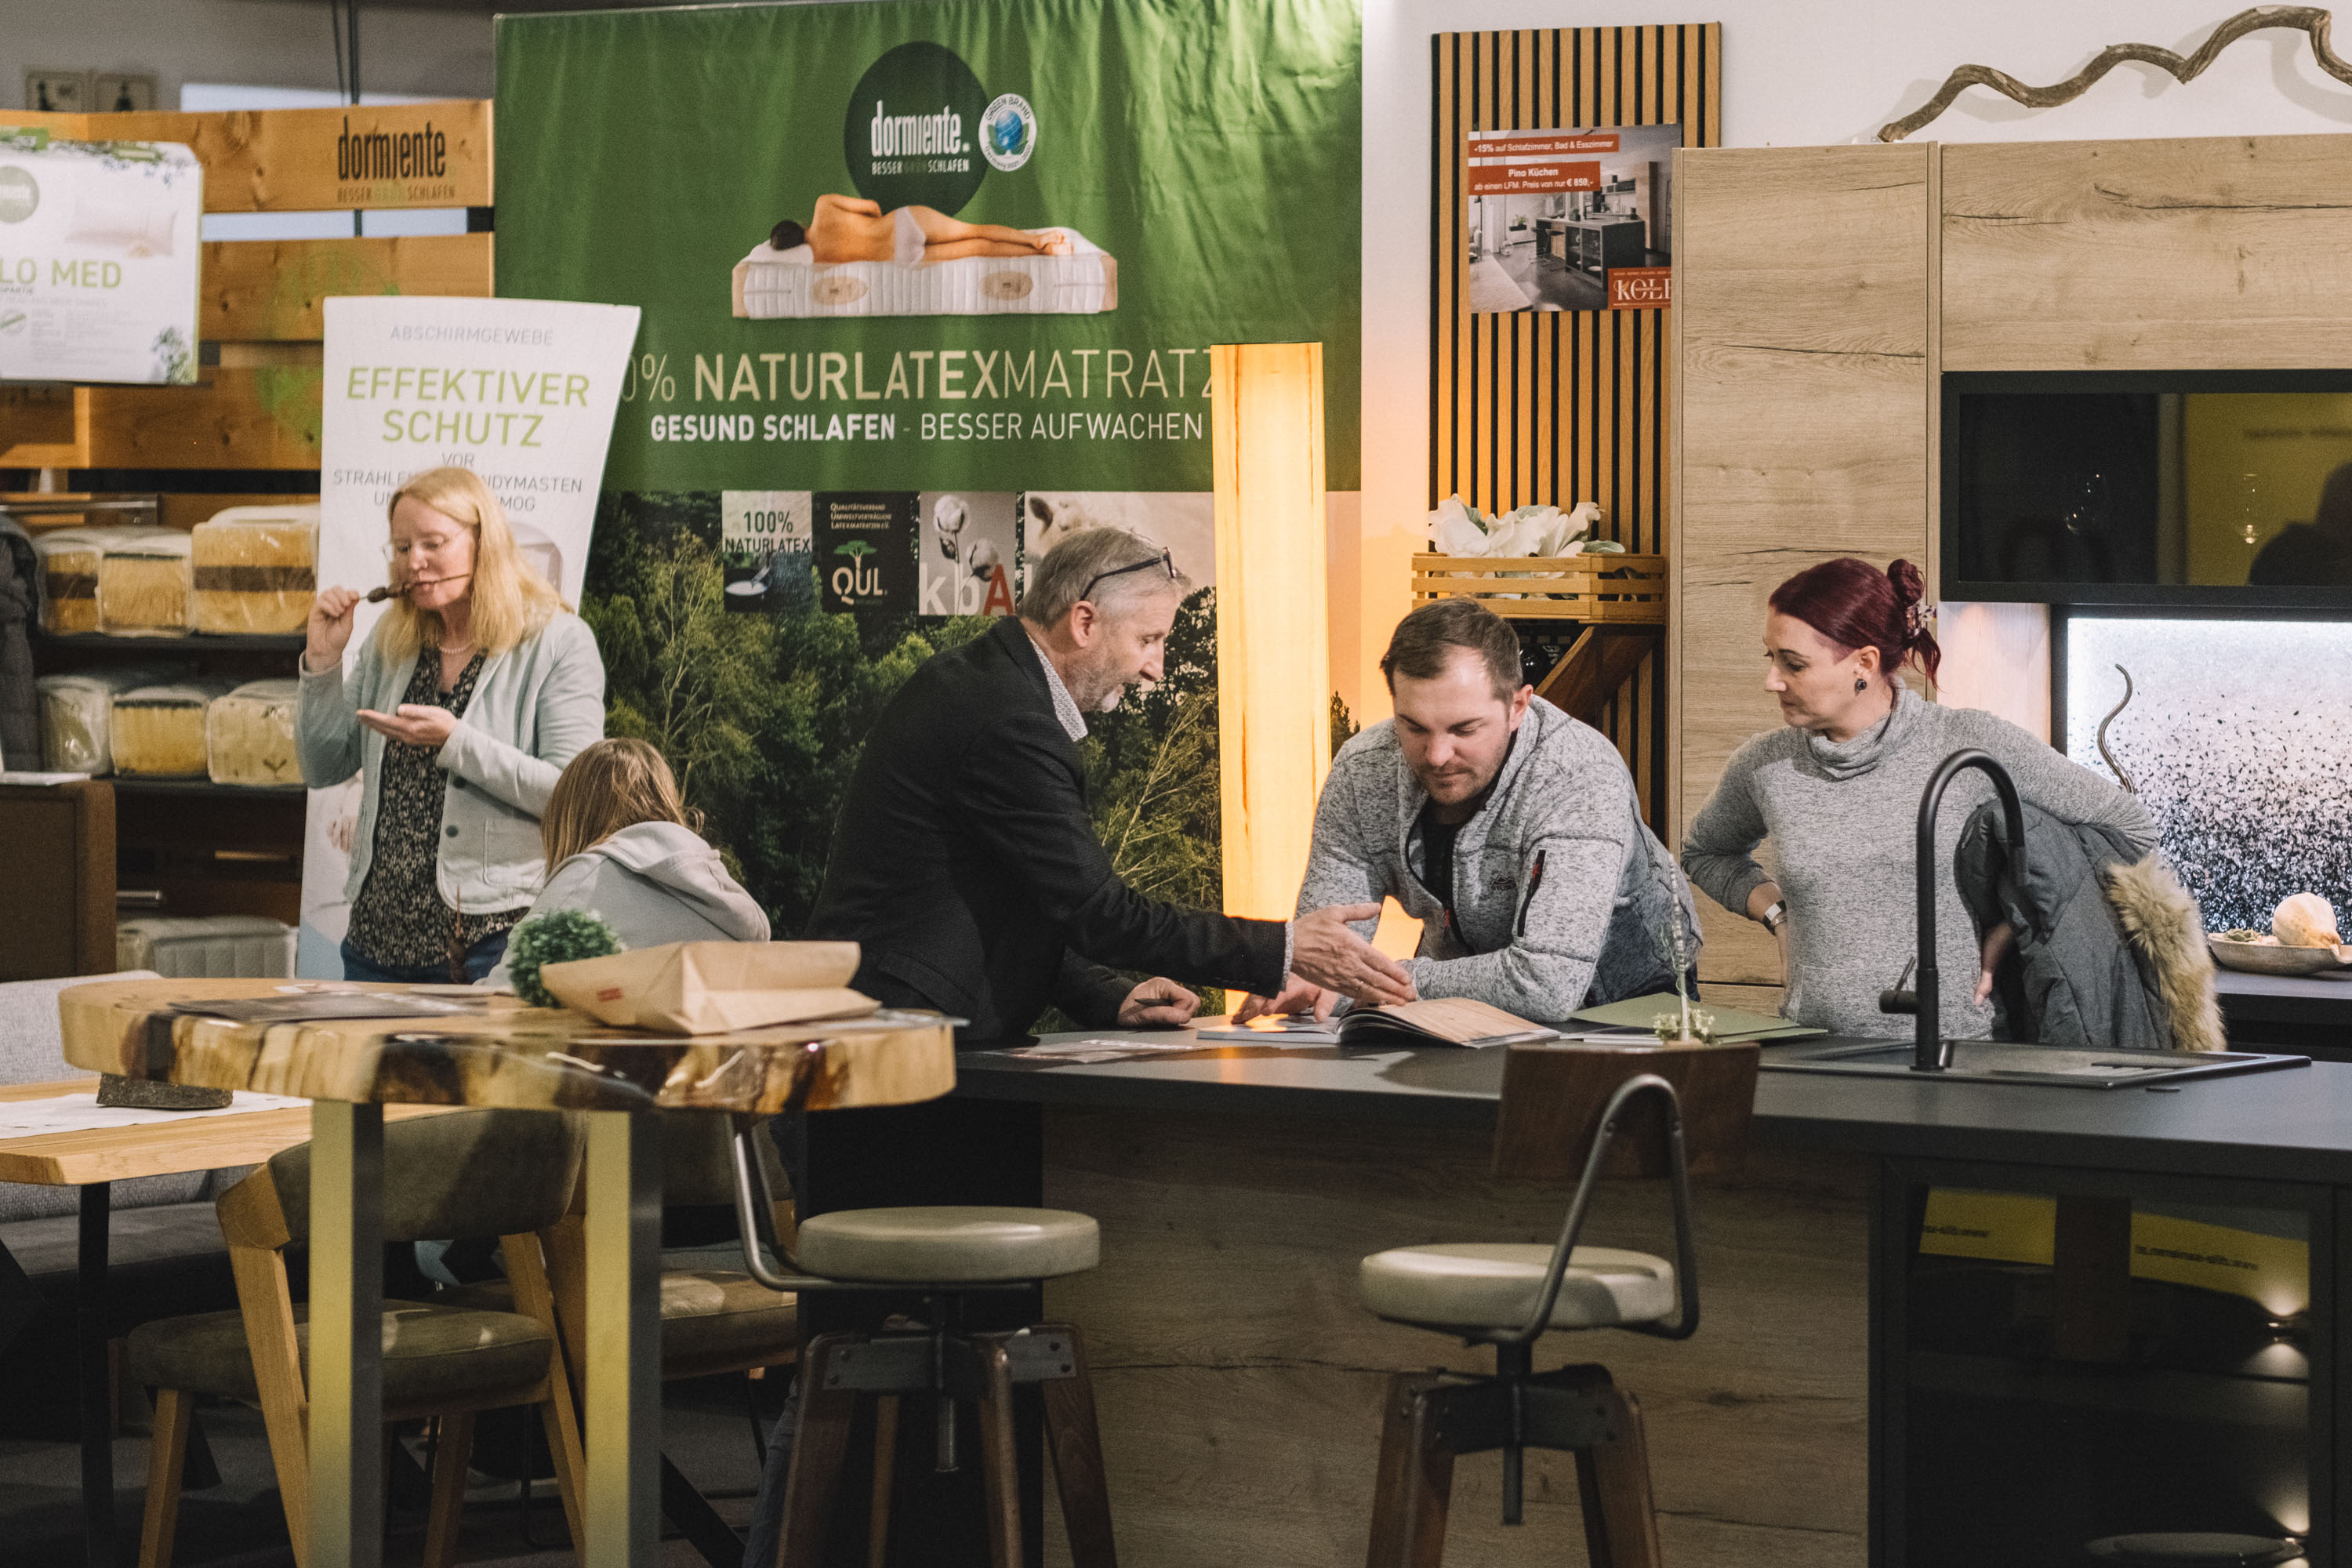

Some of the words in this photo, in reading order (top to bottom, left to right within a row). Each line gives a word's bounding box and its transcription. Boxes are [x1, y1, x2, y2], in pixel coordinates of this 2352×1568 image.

[337, 114, 446, 180] dormiente
[1507, 142, 1553, 152] Schlafzimmer,
[1555, 140, 1569, 150] Bad
[1570, 140, 1575, 149] &
[1577, 140, 1613, 149] Esszimmer
[872, 160, 902, 175] BESSER
[927, 158, 970, 172] SCHLAFEN
[1508, 169, 1526, 178] Pino
[1528, 167, 1559, 177] Küchen
[407, 184, 455, 201] SCHLAFEN
[1522, 180, 1539, 189] Preis
[51, 259, 122, 289] MED
[390, 325, 554, 347] ABSCHIRMGEWEBE
[347, 366, 590, 408] EFFEKTIVER
[382, 408, 545, 448] SCHUTZ
[651, 413, 755, 442] GESUND
[763, 413, 895, 441] SCHLAFEN
[921, 412, 1022, 441] BESSER
[1030, 412, 1203, 440] AUFWACHEN
[441, 452, 476, 467] VOR
[332, 468, 414, 486] STRAHLE
[743, 510, 793, 533] 100%
[724, 537, 811, 553] NATURLATEX
[919, 562, 1015, 616] kbA
